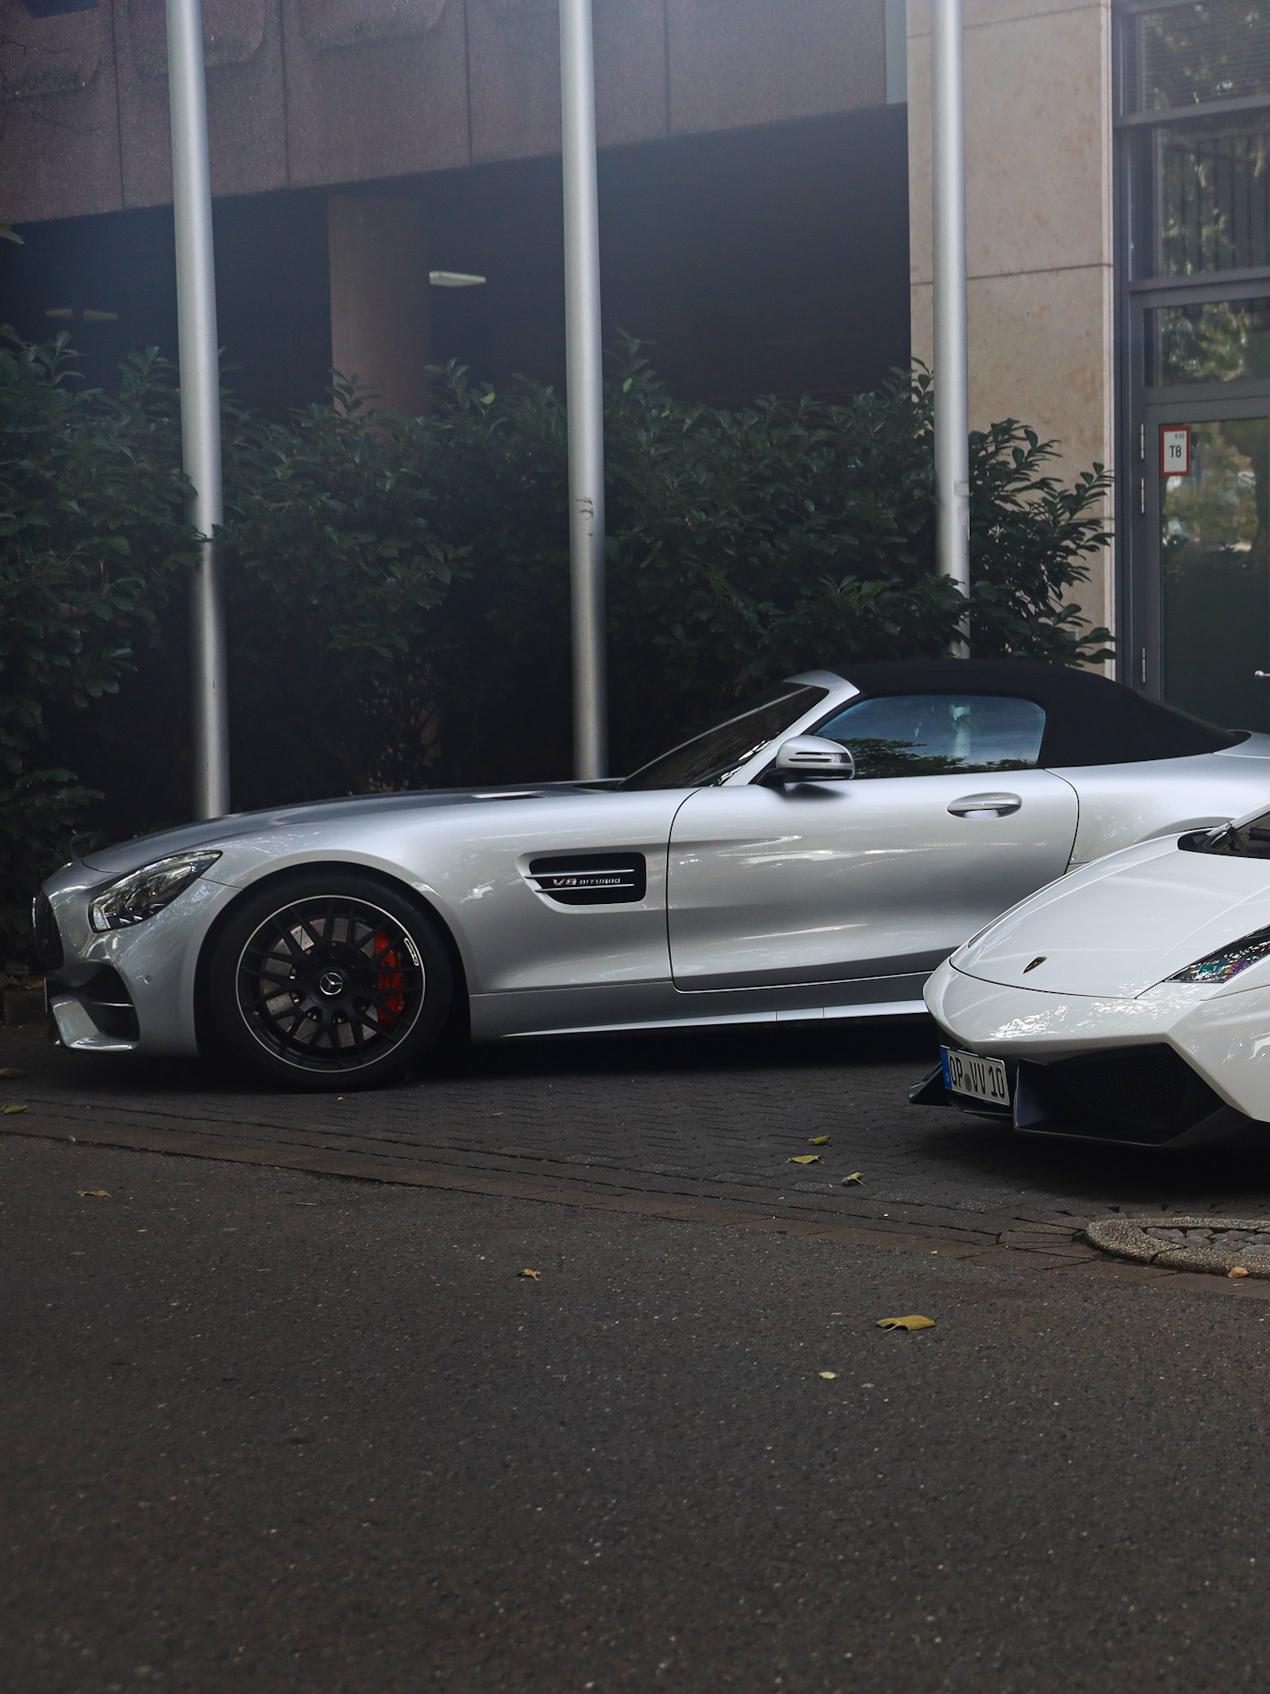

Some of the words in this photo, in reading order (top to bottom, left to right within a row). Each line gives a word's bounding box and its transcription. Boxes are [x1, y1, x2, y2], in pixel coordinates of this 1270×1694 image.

[1169, 445, 1182, 458] T8
[969, 1060, 986, 1094] VV
[988, 1065, 1006, 1098] 10
